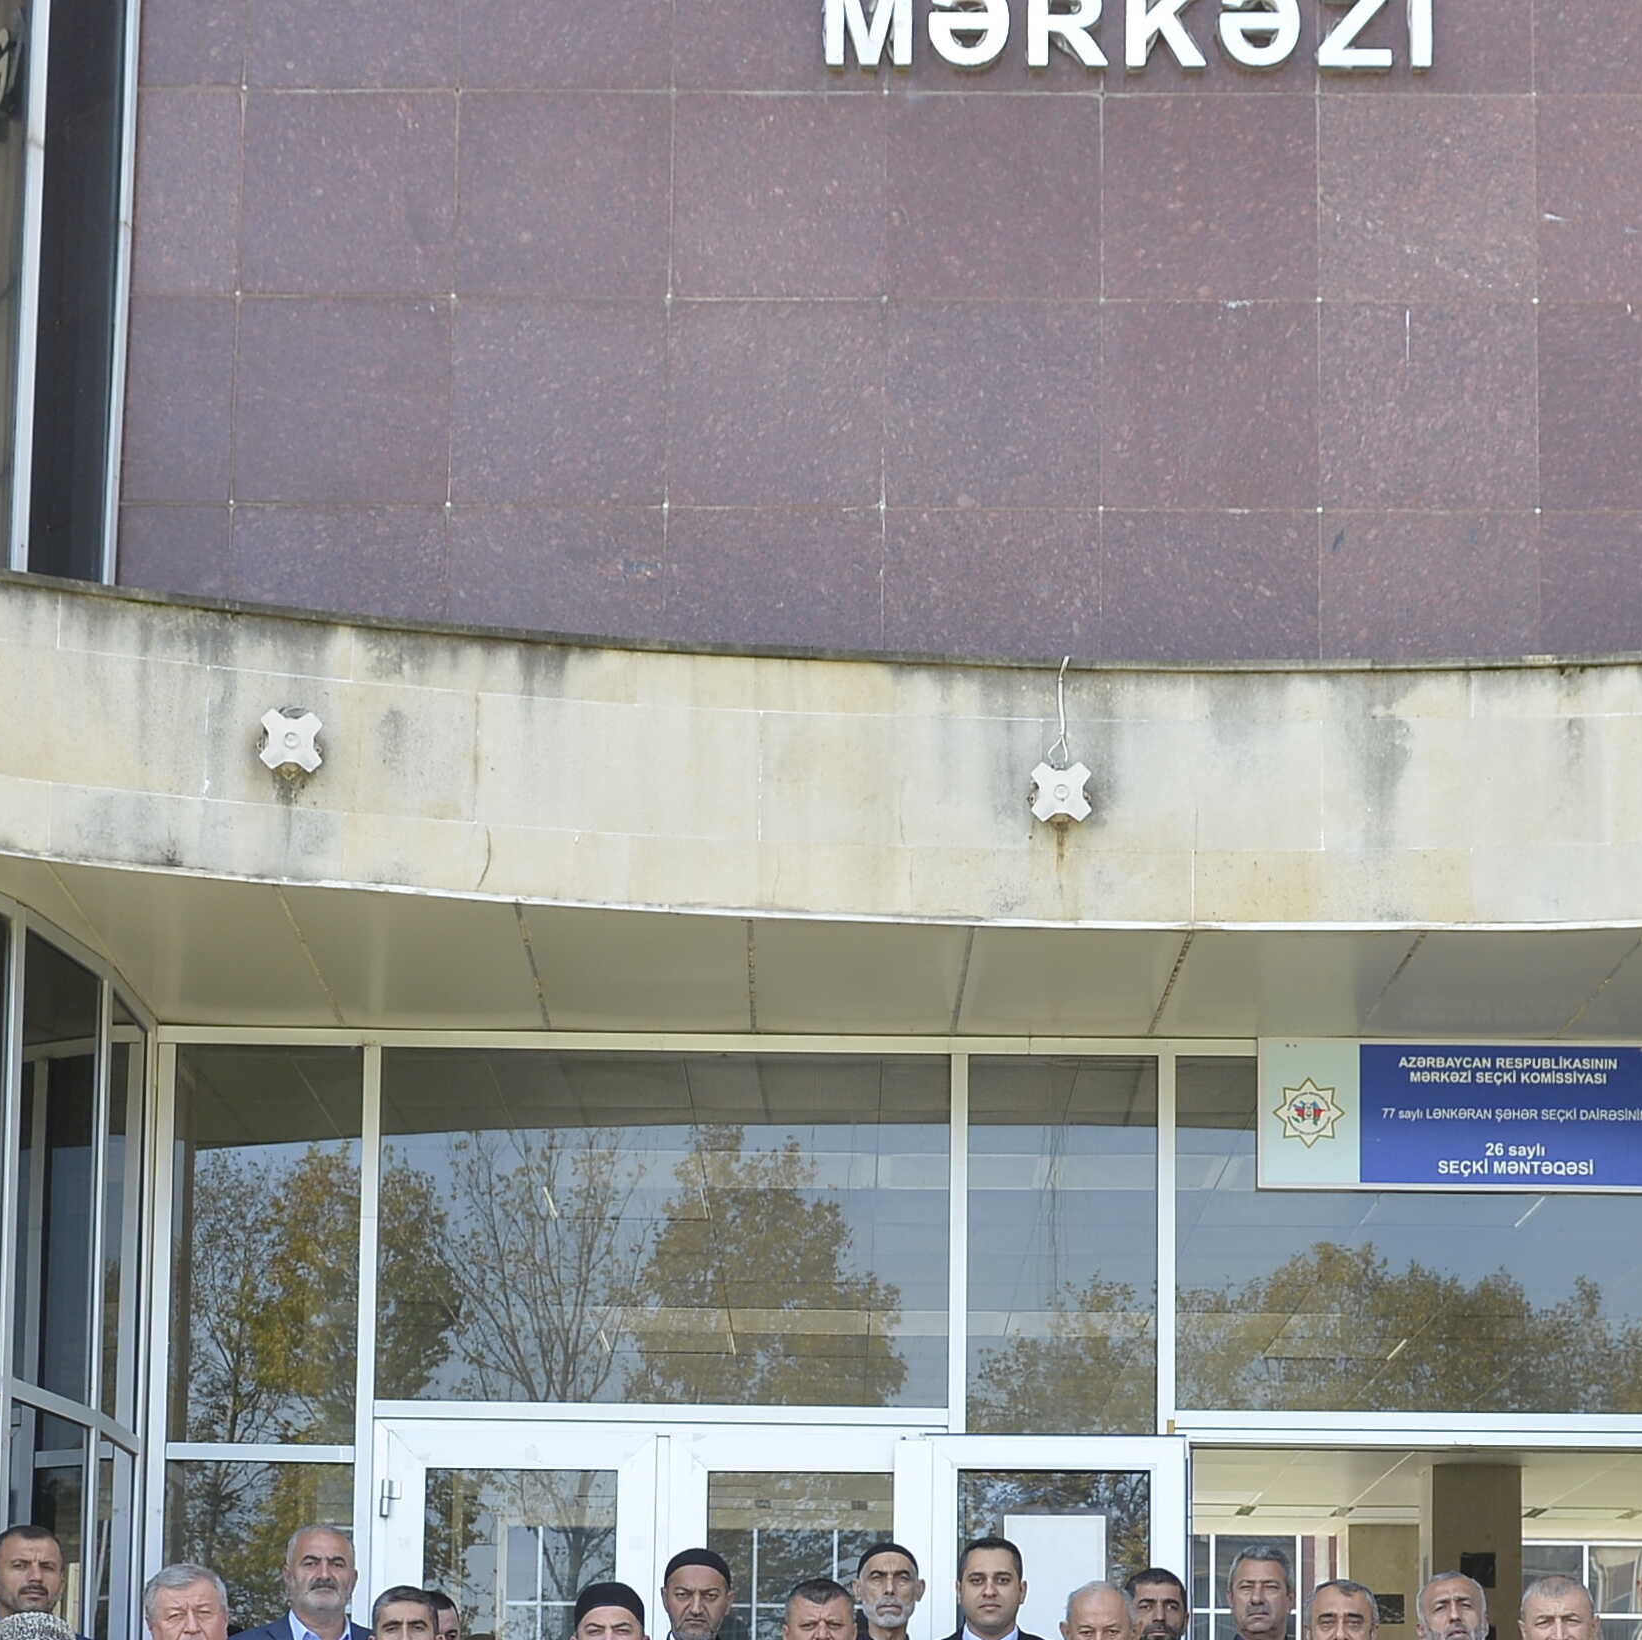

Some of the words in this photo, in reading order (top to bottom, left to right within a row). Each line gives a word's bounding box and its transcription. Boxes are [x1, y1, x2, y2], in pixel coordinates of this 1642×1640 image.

[1398, 1056, 1491, 1069] AZƏRBAYCAN
[1495, 1055, 1618, 1070] RESPUBLİKASININ
[1409, 1071, 1472, 1084] MƏRKƏZİ
[1476, 1071, 1517, 1086] SEÇKİ
[1520, 1071, 1607, 1084] KOMİSSİYASI
[1382, 1107, 1396, 1119] 77
[1398, 1108, 1423, 1122] saylı
[1425, 1107, 1492, 1120] LƏNKƏRAN
[1495, 1108, 1538, 1122] ŞƏHƏR
[1541, 1107, 1577, 1123] SEÇKİ
[1485, 1142, 1504, 1156] 26
[1508, 1142, 1546, 1160] saylı
[1437, 1158, 1488, 1177] SEÇKİ
[1493, 1158, 1594, 1176] MƏNTƏQƏSİ
